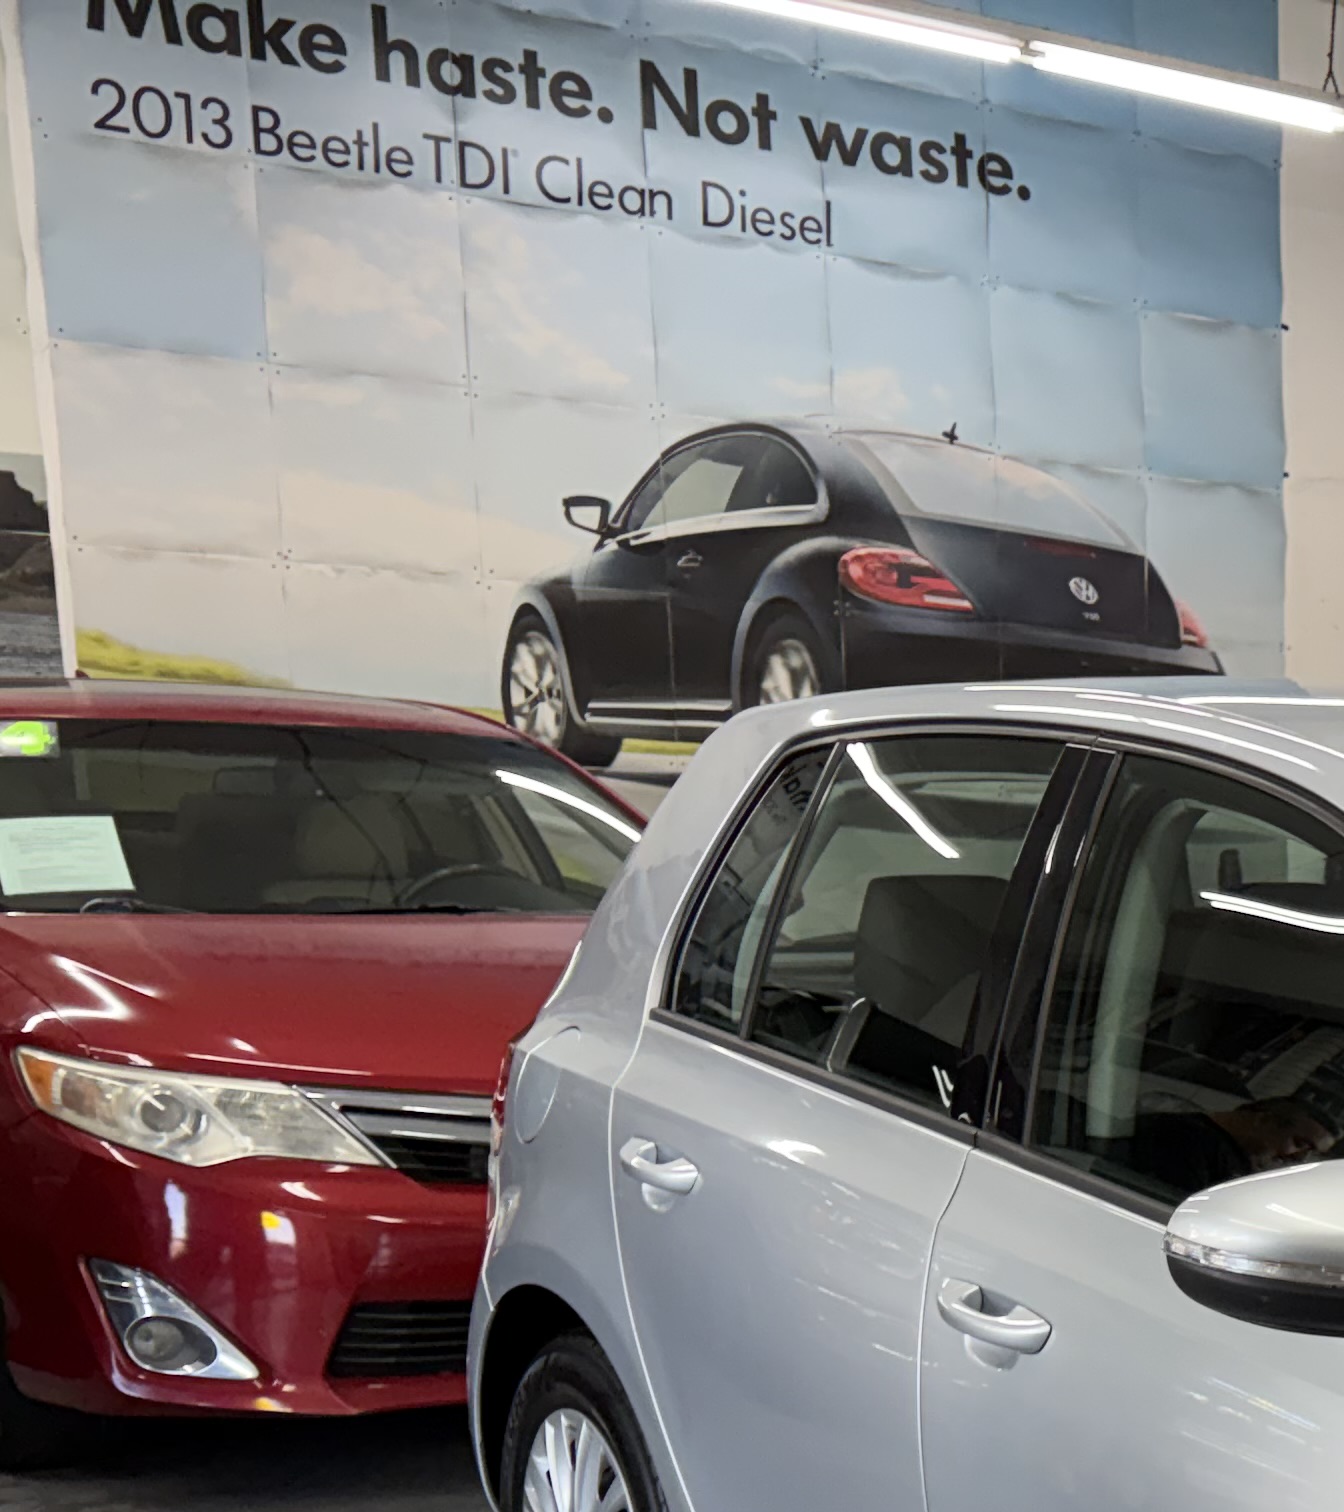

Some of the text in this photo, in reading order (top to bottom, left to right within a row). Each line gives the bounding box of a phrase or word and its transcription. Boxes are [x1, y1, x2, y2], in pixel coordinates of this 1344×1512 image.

[89, 78, 234, 150] 2013
[250, 105, 414, 178] Beetle
[535, 155, 674, 221] Clean
[701, 181, 834, 247] Diesel
[371, 4, 614, 124] haste.
[639, 58, 778, 151] Not
[800, 114, 1032, 201] waste.
